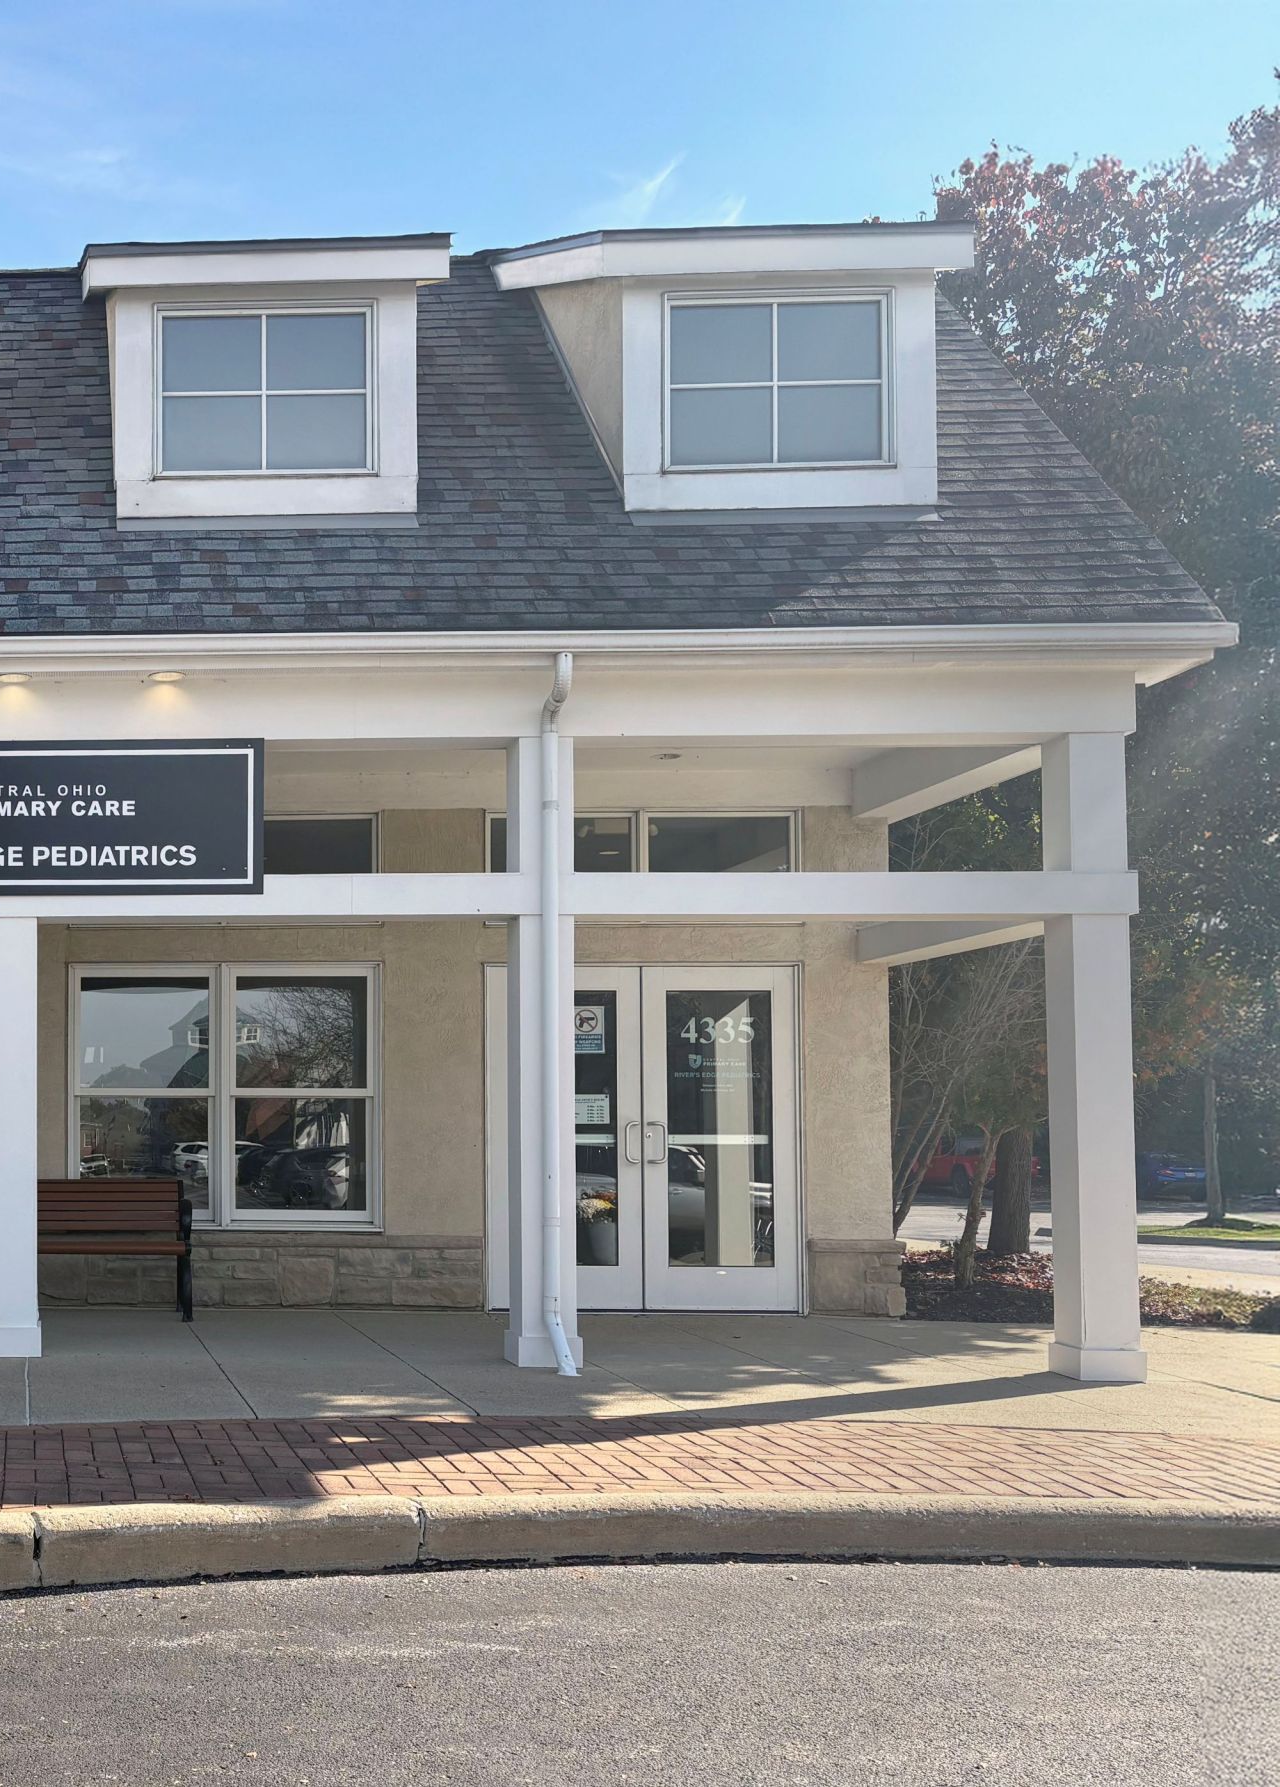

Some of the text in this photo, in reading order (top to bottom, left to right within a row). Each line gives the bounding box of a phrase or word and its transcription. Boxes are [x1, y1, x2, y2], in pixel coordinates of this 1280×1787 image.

[58, 784, 107, 797] OHIO
[71, 800, 136, 816] CARE
[33, 844, 197, 867] PEDIATRICS
[680, 1016, 755, 1044] 4335
